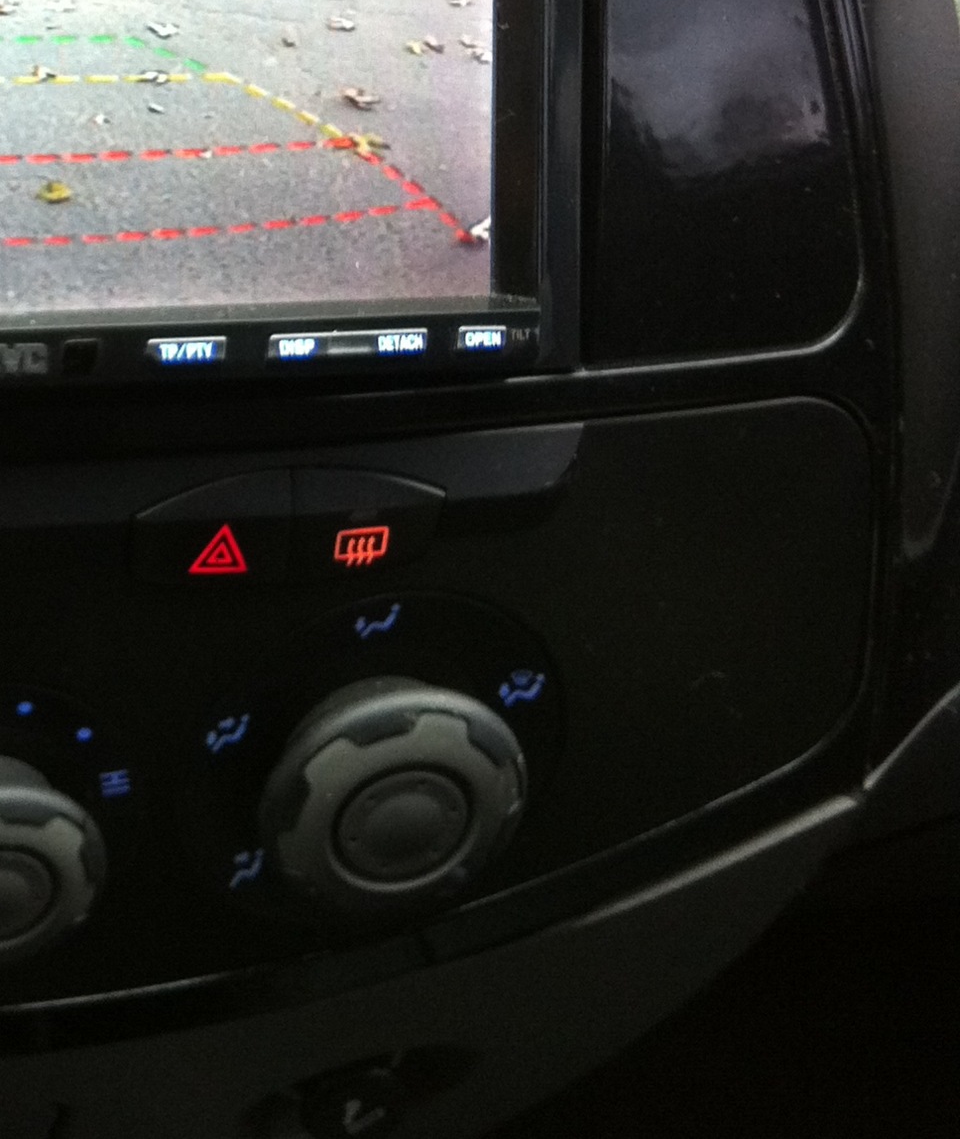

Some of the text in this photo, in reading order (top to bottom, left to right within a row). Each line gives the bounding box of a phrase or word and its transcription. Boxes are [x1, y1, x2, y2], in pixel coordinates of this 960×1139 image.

[279, 339, 316, 357] DISP
[378, 334, 423, 353] DETACH
[465, 331, 502, 348] OPEN
[158, 341, 214, 360] TP/PTY
